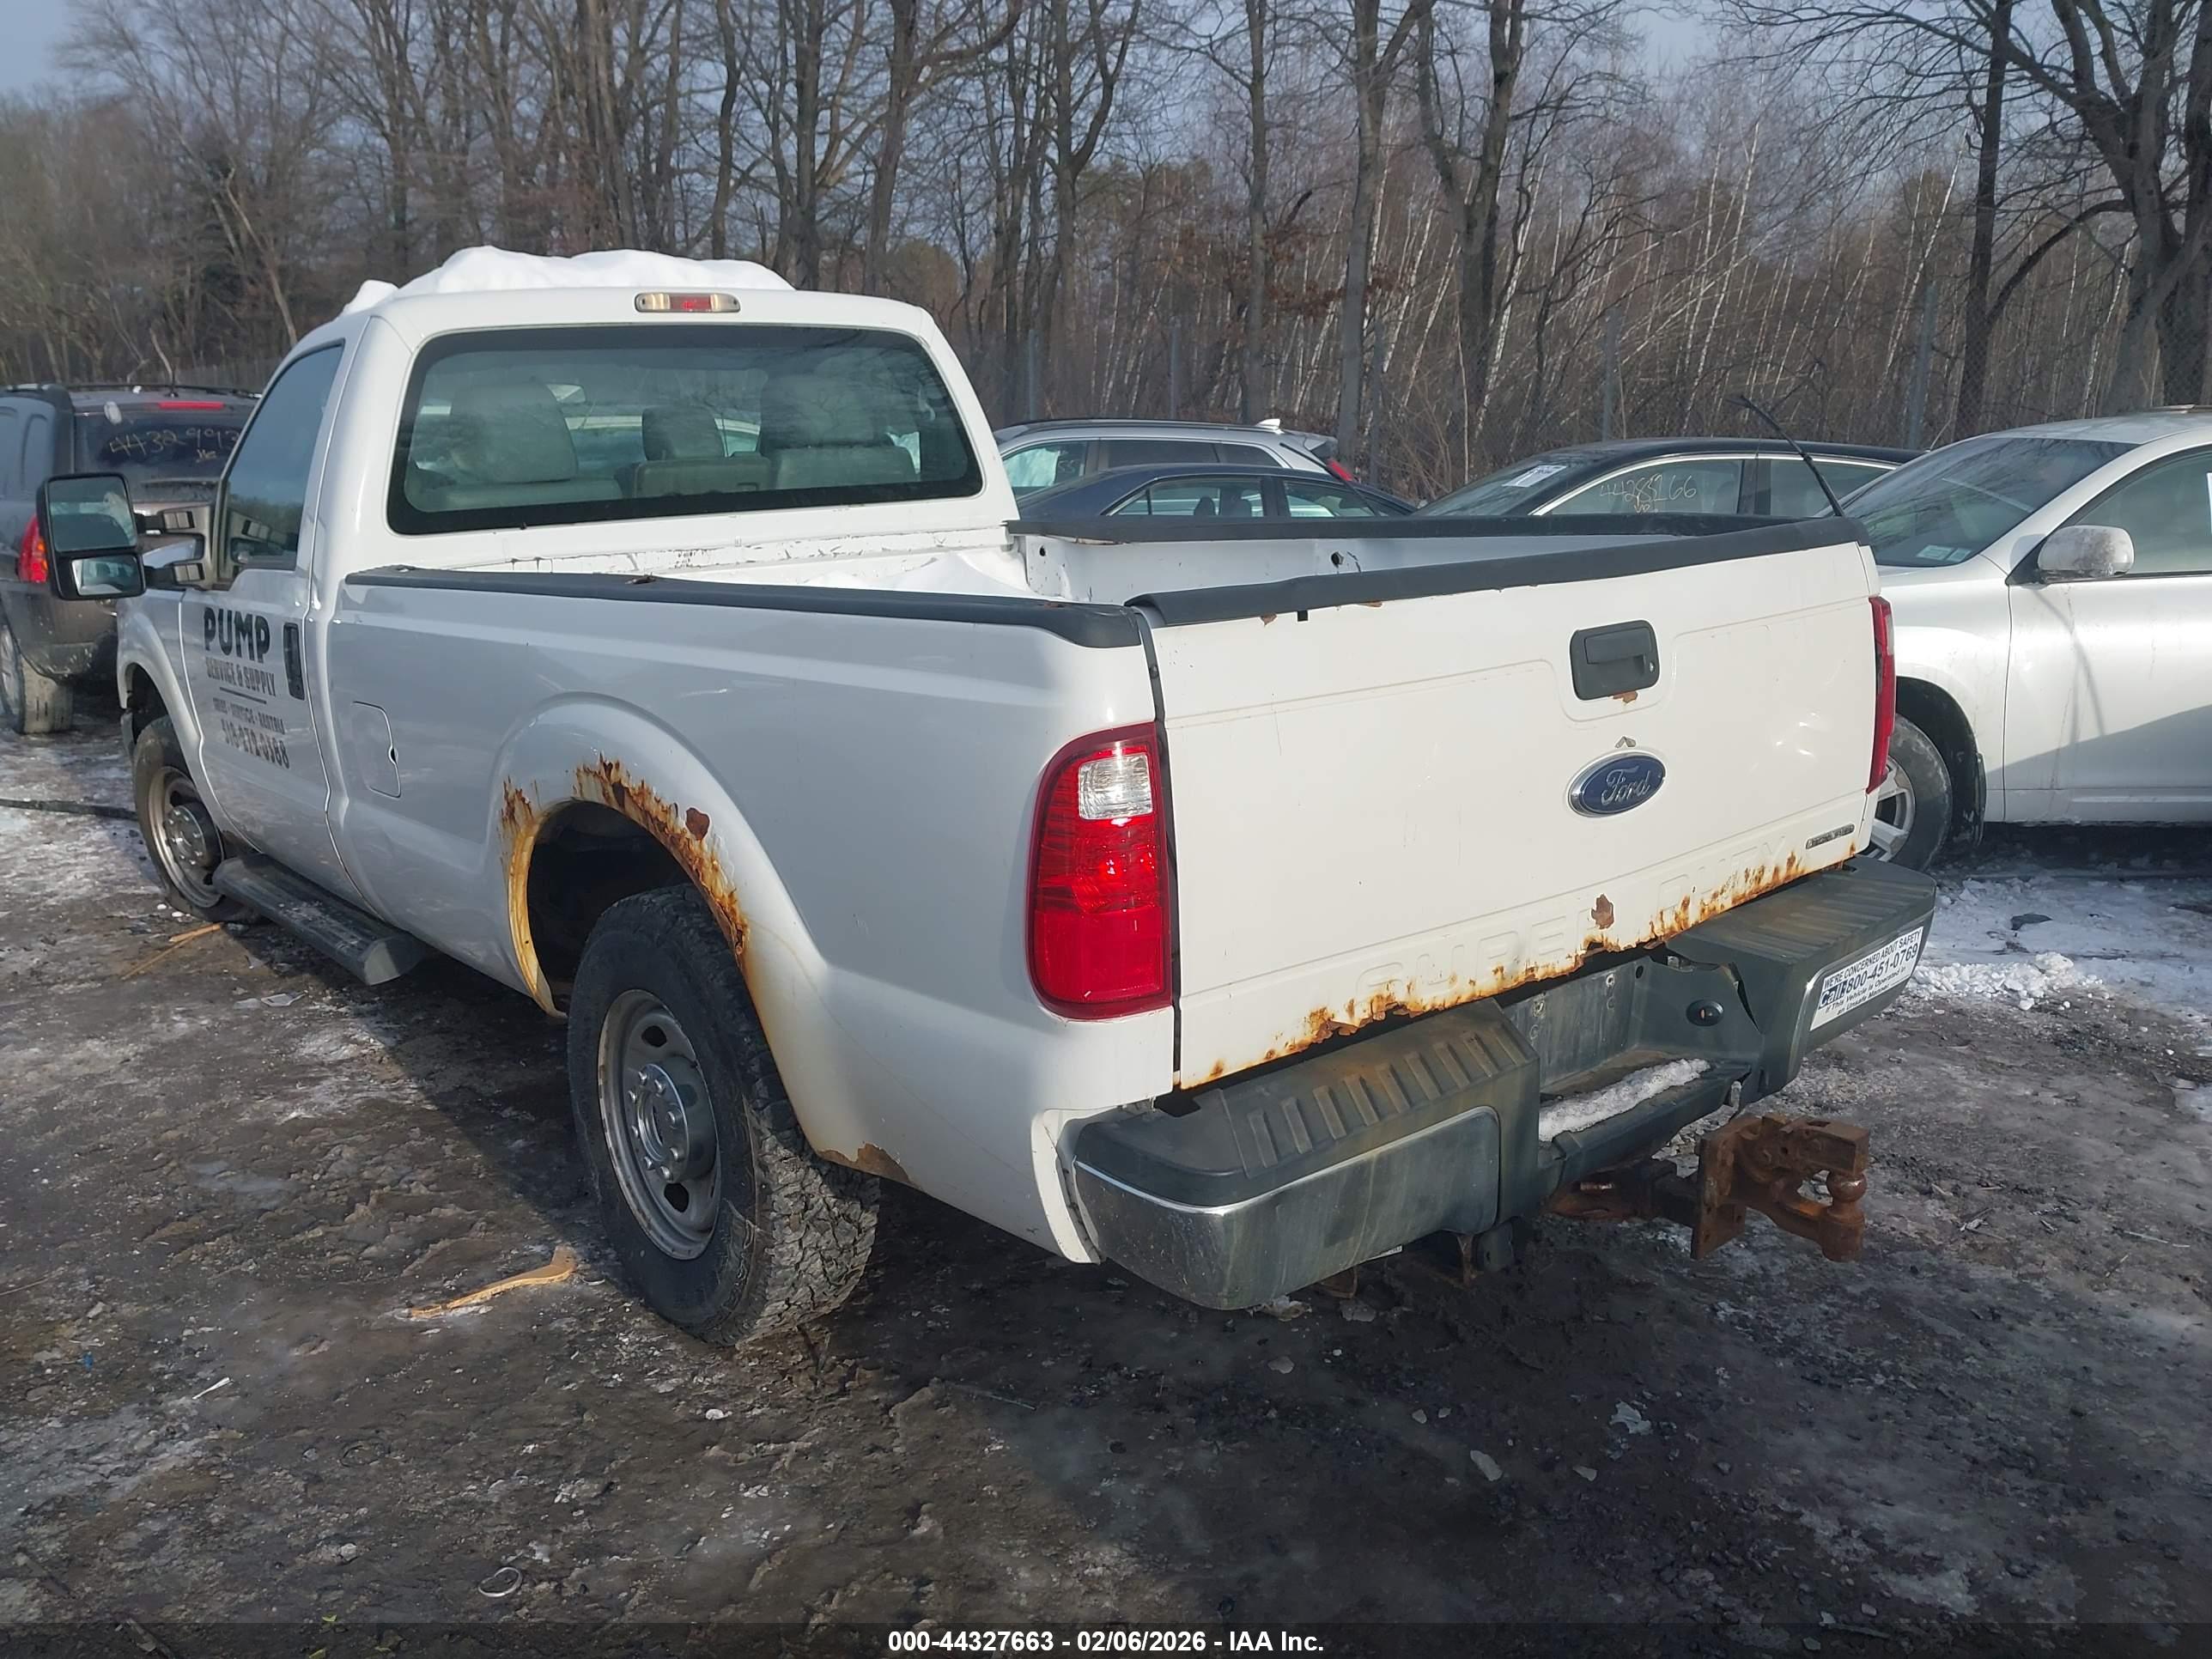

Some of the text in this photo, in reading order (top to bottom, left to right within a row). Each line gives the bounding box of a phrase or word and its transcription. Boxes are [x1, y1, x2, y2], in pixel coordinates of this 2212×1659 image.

[204, 606, 270, 664] PUMP
[206, 657, 276, 696] SERVICE & SUPPLY
[1601, 765, 1651, 805] Ford
[1824, 929, 1921, 989] WE'RE CONCERNED ABOUT SAFETY
[1846, 943, 1918, 994] 800-451-0769
[1846, 987, 1867, 1002] Vehicle
[1875, 969, 1900, 988] Operated
[1846, 996, 1867, 1010] Unsafe
